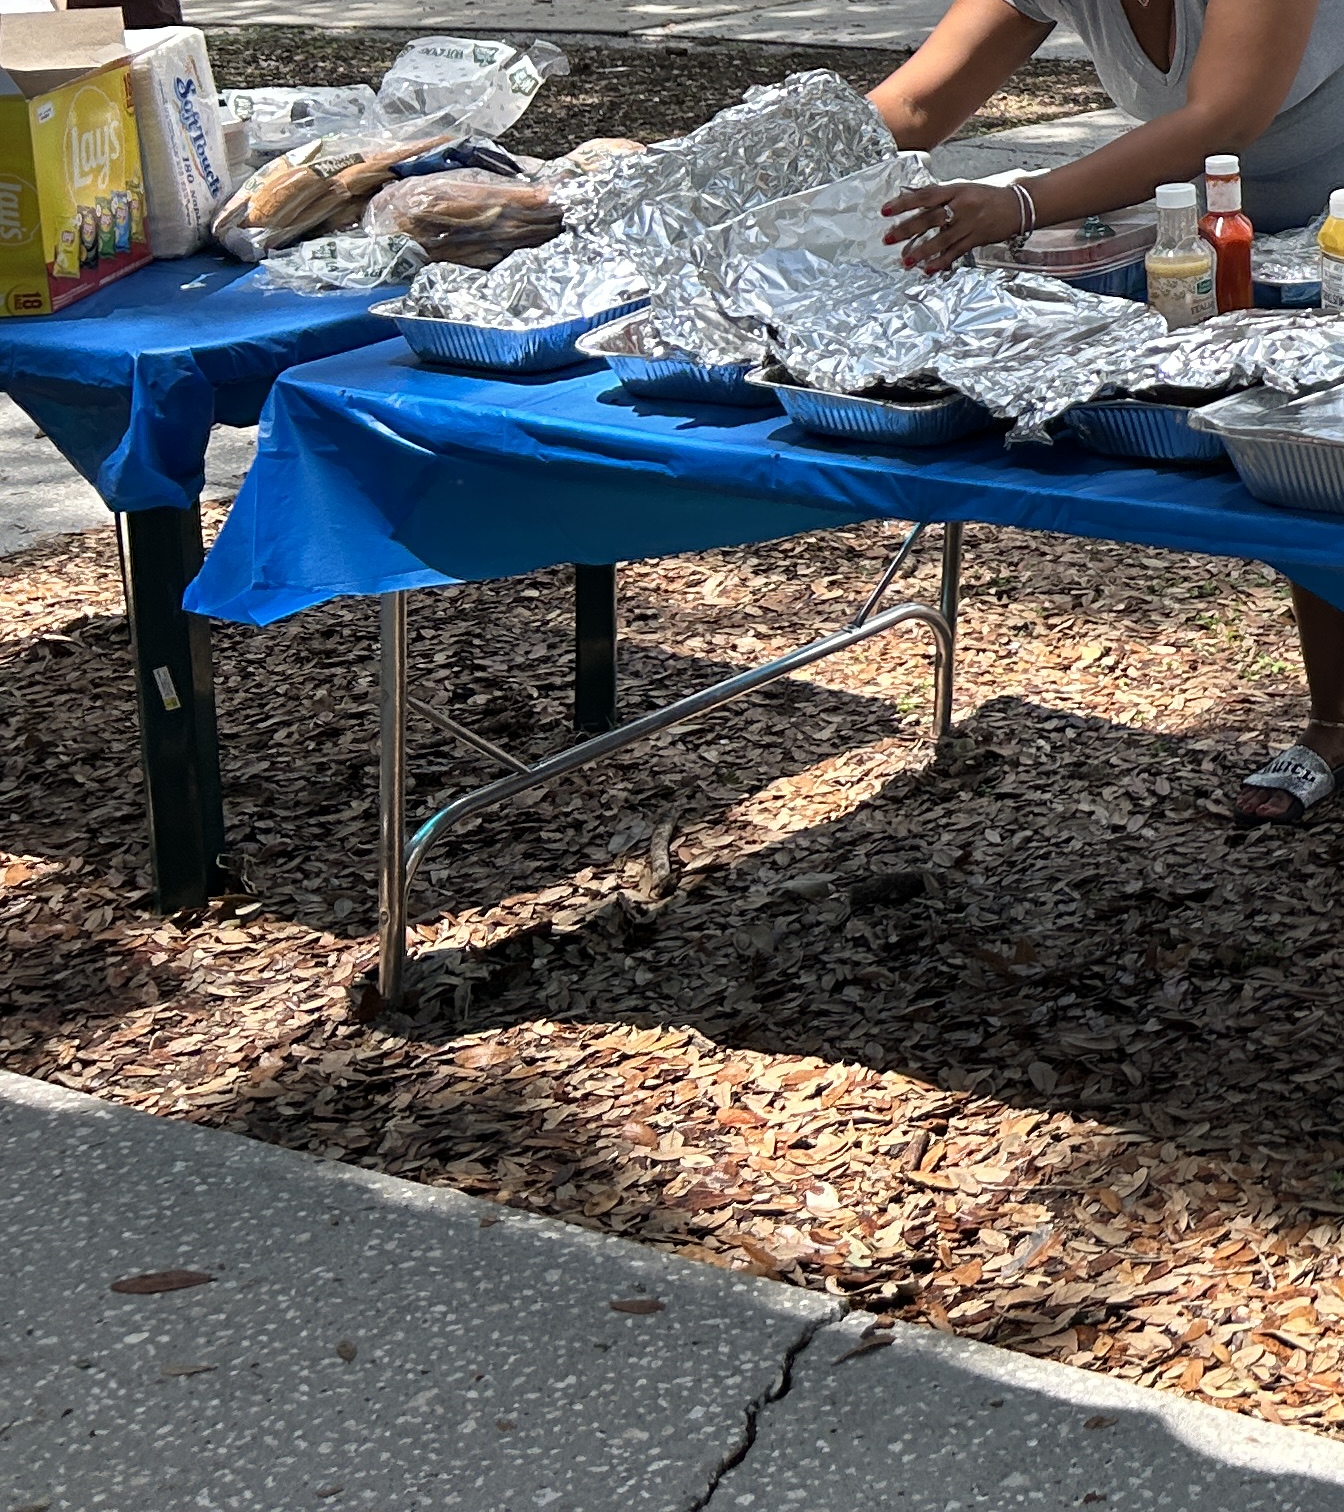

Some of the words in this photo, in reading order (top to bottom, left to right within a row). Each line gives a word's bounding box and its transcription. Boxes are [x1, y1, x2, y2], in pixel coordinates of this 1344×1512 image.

[71, 110, 121, 189] Lay's
[182, 156, 196, 185] 180
[22, 291, 43, 311] 18
